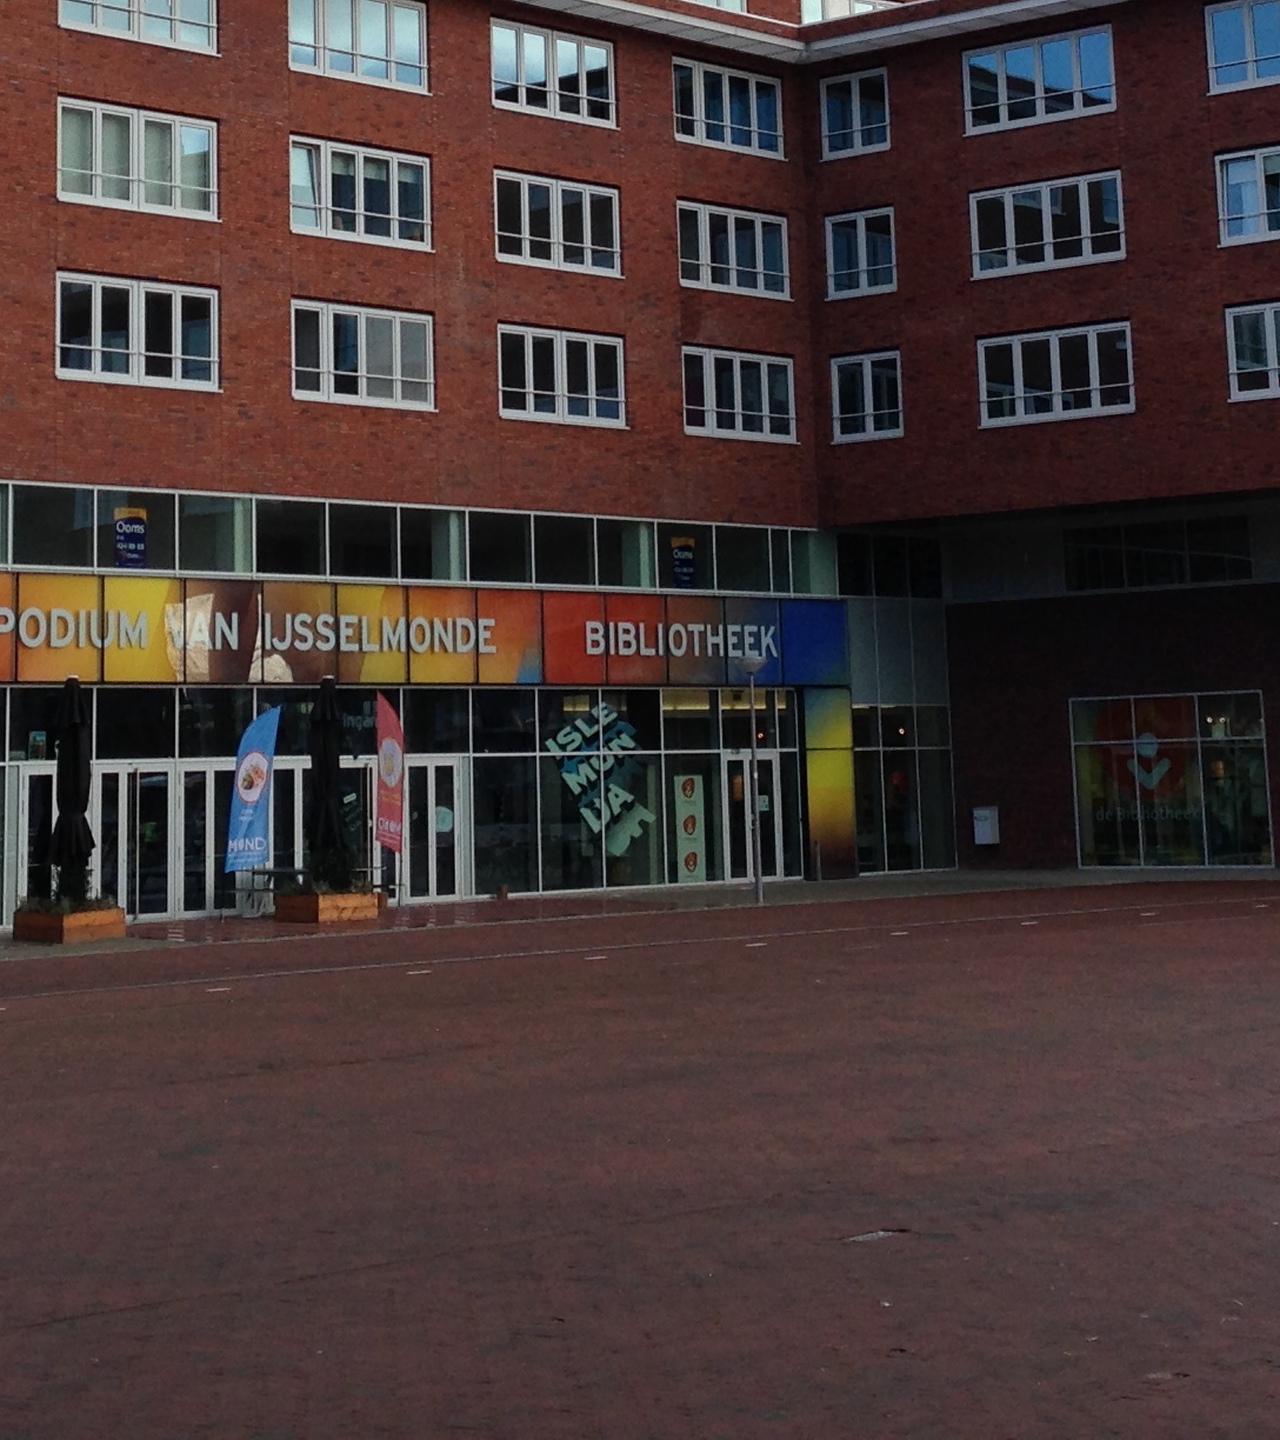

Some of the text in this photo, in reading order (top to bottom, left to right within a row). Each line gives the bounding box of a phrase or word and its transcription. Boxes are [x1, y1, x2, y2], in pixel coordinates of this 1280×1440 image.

[169, 611, 239, 650] VAN
[264, 612, 497, 653] IJSSELMONDE
[586, 621, 778, 657] BIBLIOTHEEK
